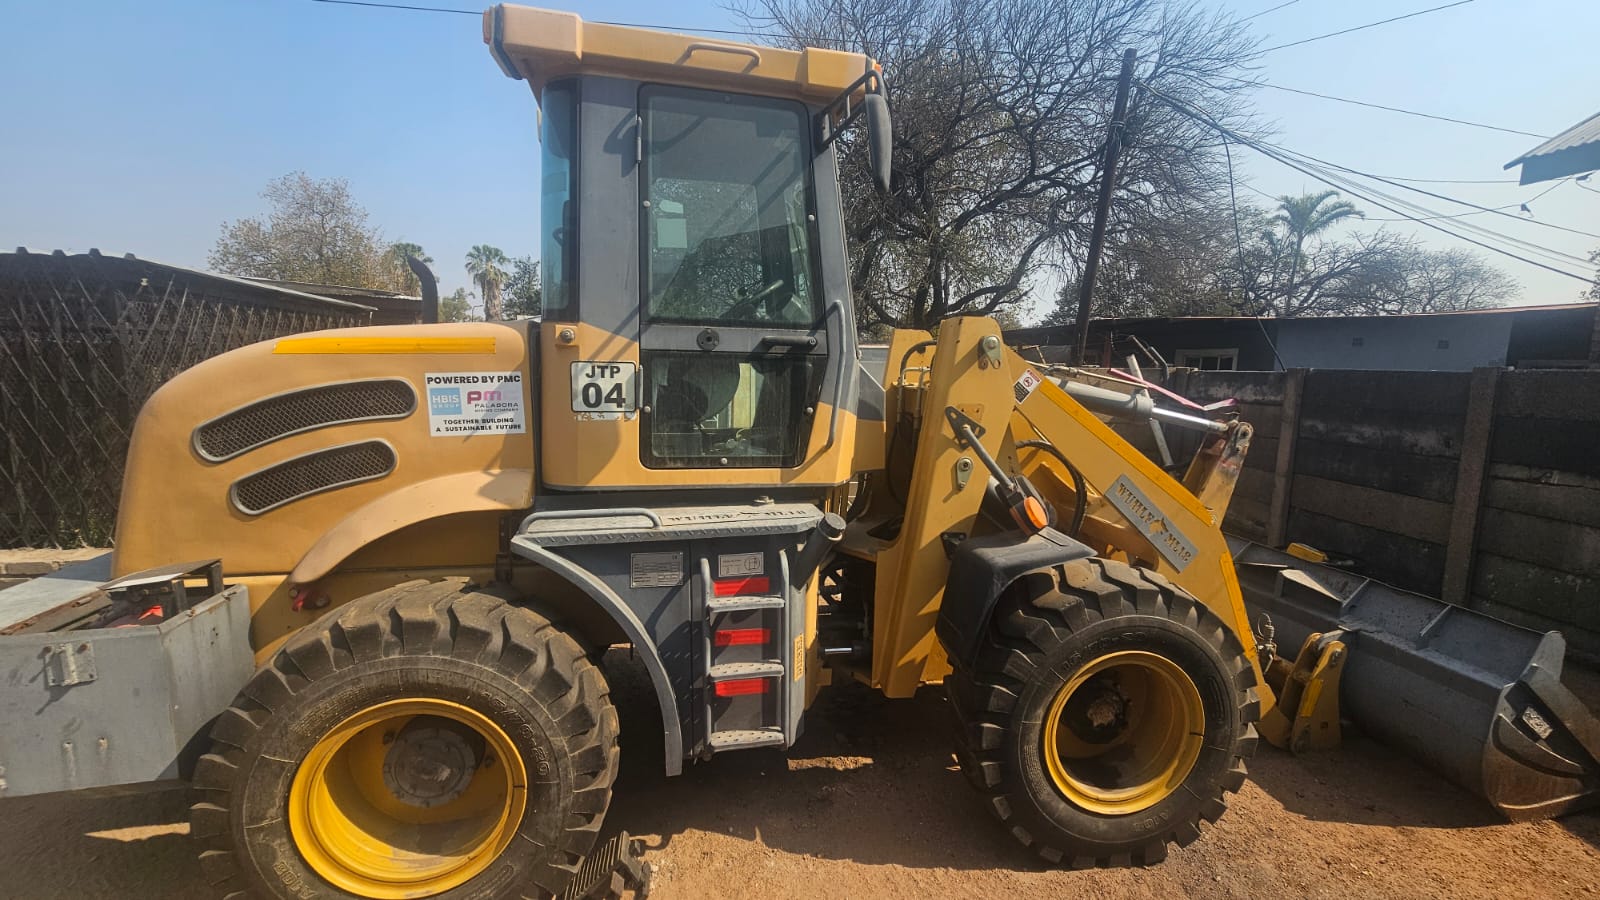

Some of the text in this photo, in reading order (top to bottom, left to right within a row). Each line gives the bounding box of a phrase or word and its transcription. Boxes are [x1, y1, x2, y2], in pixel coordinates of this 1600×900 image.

[585, 365, 621, 379] JTP
[427, 375, 521, 384] POWERED BY PMC
[432, 394, 460, 404] HBIS
[582, 382, 627, 409] 04
